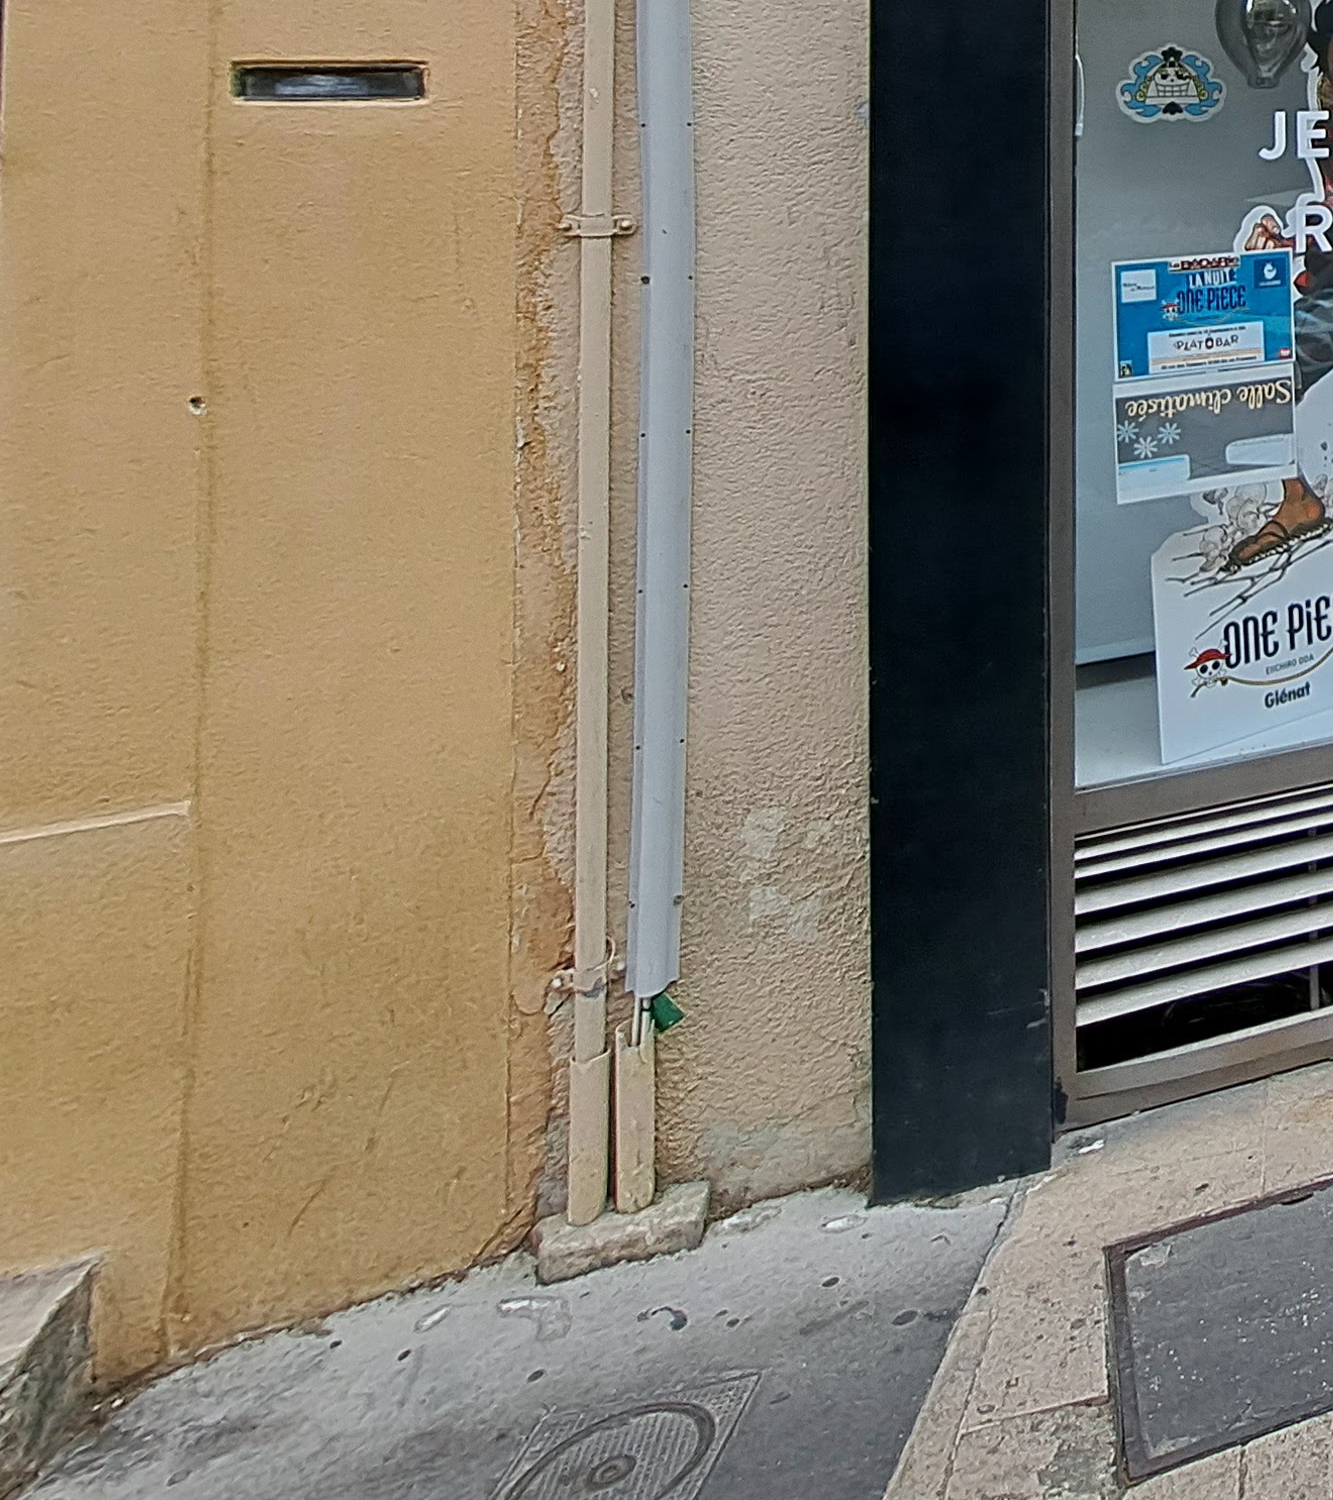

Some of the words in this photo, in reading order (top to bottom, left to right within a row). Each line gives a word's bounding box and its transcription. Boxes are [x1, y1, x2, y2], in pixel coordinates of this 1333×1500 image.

[1124, 388, 1232, 422] climatisée
[1236, 378, 1293, 410] Salle
[1223, 610, 1280, 670] ONE
[1264, 681, 1311, 709] Glénat
